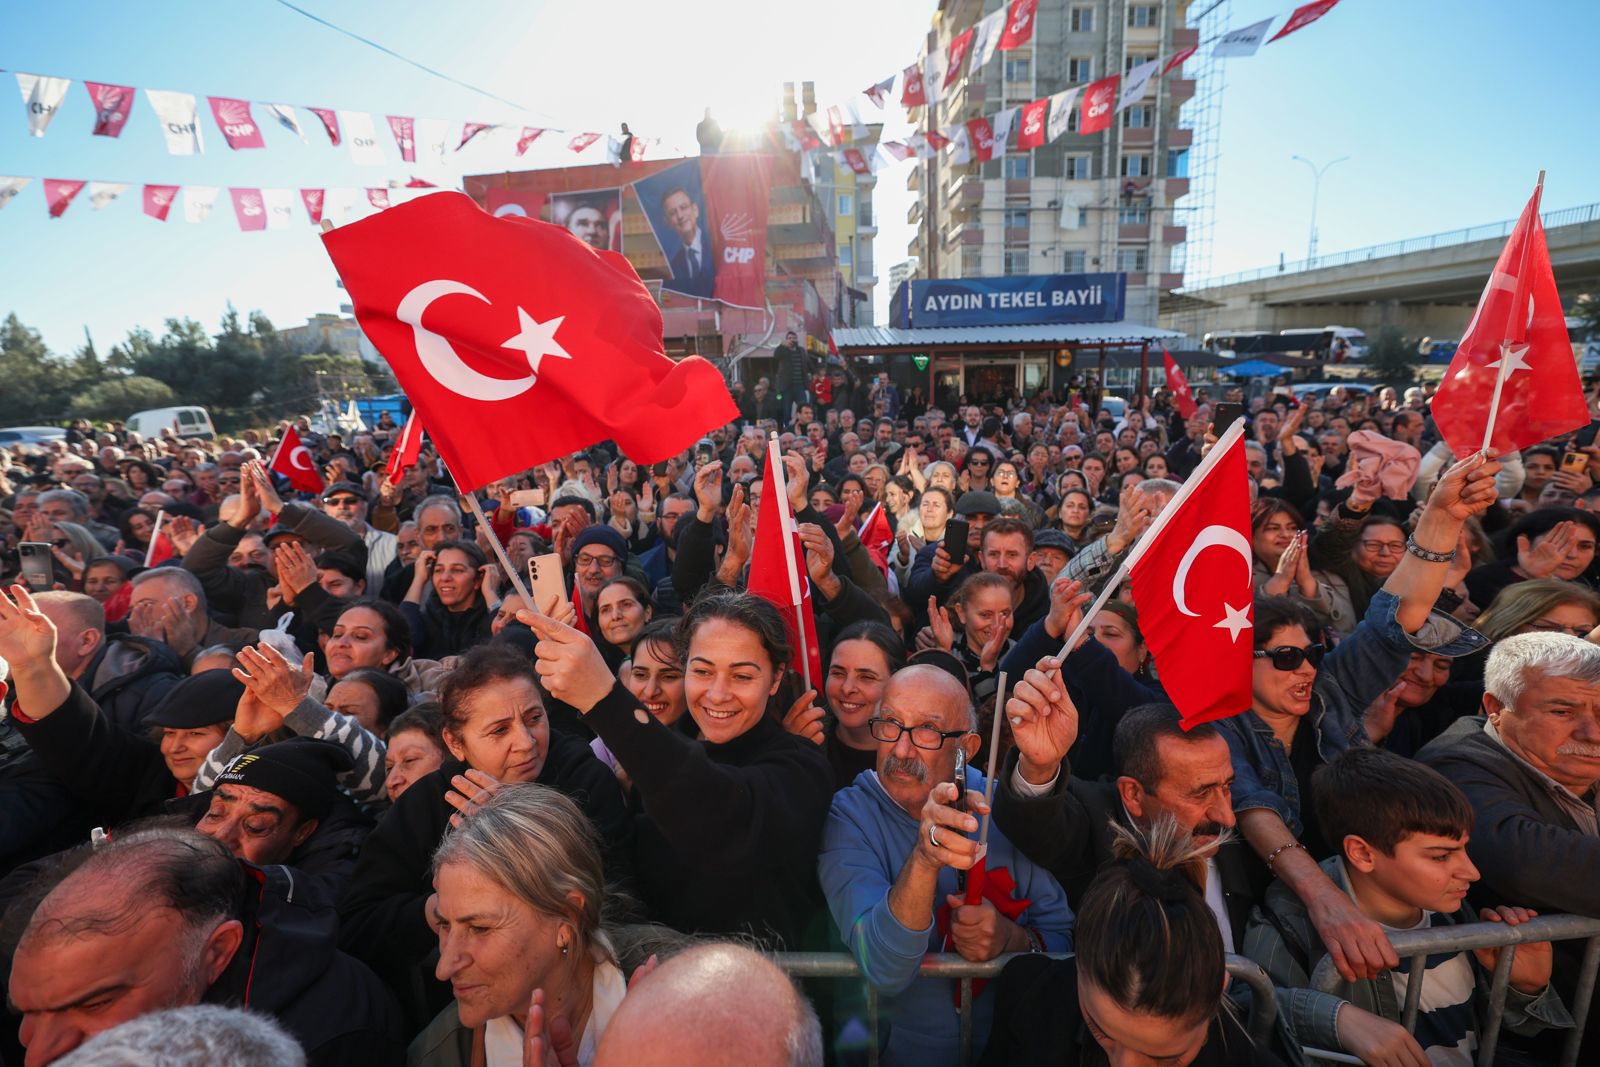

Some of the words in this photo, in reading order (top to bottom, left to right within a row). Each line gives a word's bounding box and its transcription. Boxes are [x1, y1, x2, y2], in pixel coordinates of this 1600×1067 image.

[1088, 102, 1109, 118] CHP
[224, 123, 254, 137] CHP
[724, 246, 755, 264] CHP
[925, 294, 983, 311] AYDIN
[988, 291, 1047, 309] TEKEL
